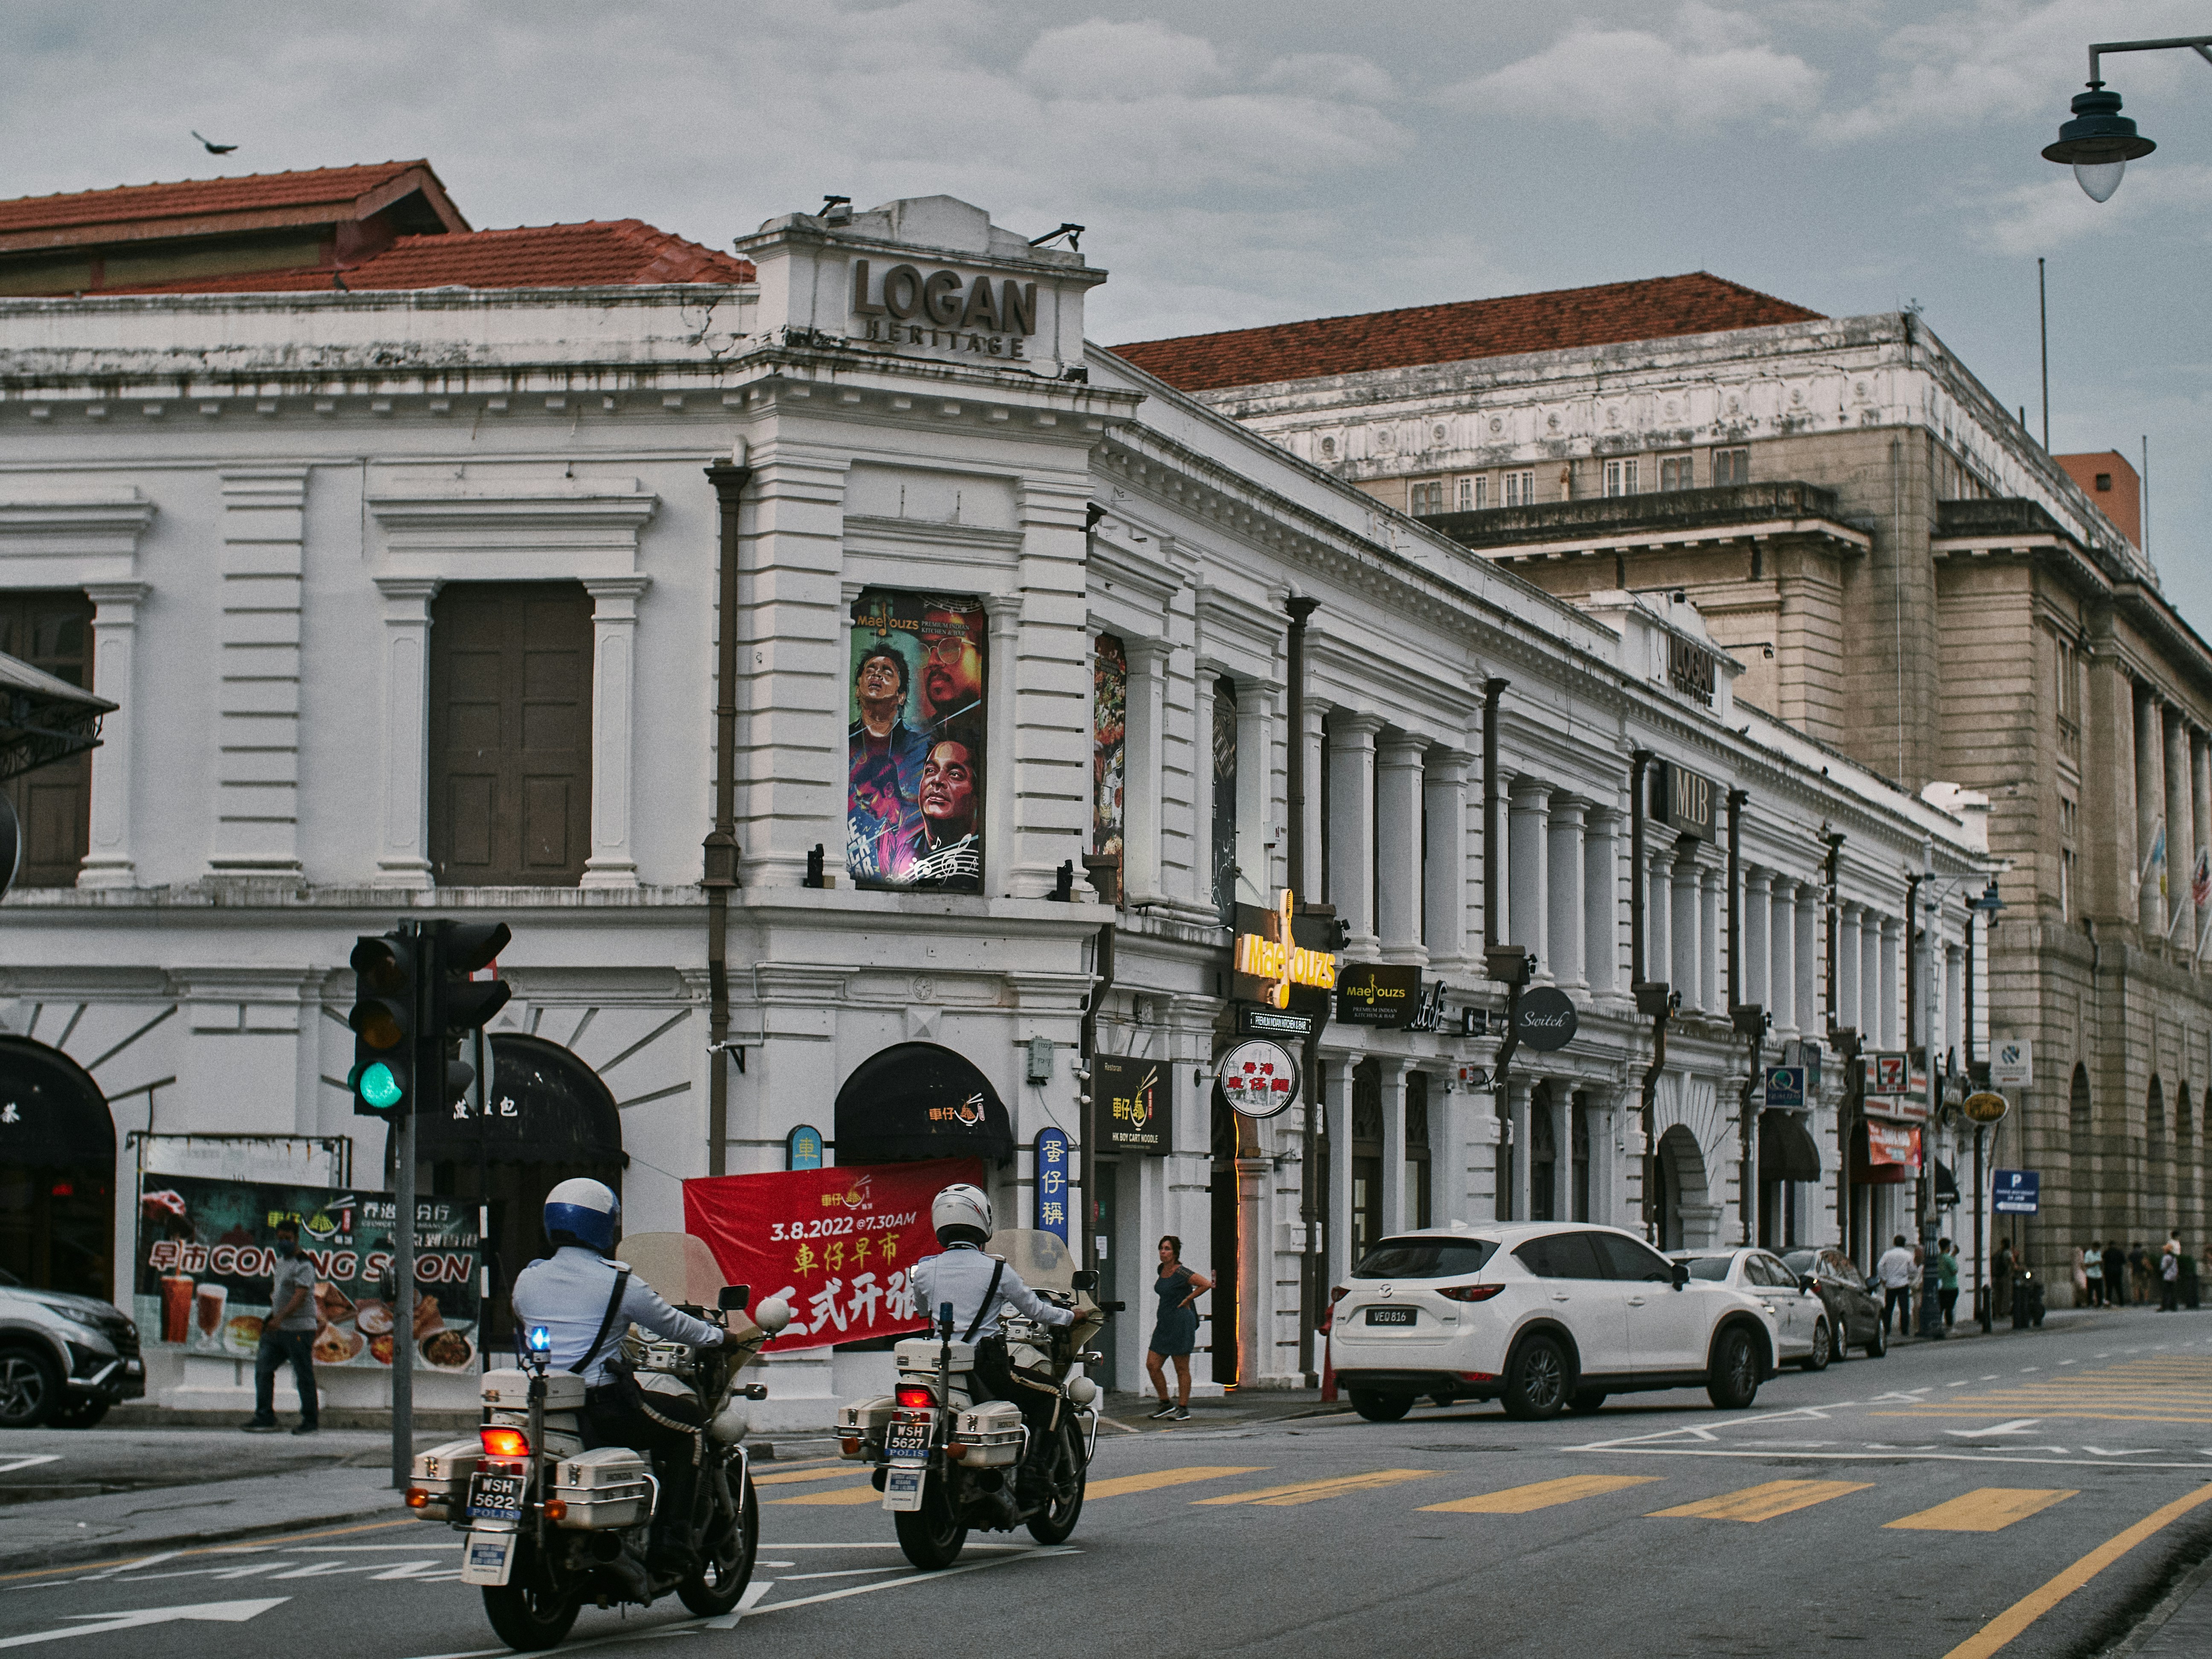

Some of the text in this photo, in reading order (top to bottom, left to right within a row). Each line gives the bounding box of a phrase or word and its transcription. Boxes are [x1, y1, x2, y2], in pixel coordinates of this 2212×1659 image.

[854, 259, 1037, 335] LOGAN
[865, 319, 1025, 358] HERITAGE
[921, 621, 949, 629] PREMIUM
[1670, 635, 1715, 694] LOGAN
[1676, 767, 1708, 825] MIB
[1411, 981, 1447, 1030] itch
[1520, 1010, 1570, 1027] Switch
[1105, 1062, 1122, 1072] Restoran
[1243, 1062, 1274, 1076] 香港
[1112, 1132, 1158, 1143] HK BOY CART NOODLE
[2011, 1173, 2022, 1188] P
[770, 1211, 917, 1241] 3.8.2022 @7.30AM
[794, 1232, 899, 1278] 車仔早市
[210, 1244, 359, 1281] COMNG
[362, 1251, 473, 1283] SON
[1391, 1311, 1406, 1322] 816
[897, 1426, 923, 1437] WSH
[892, 1437, 924, 1449] 5627
[482, 1478, 514, 1493] WSH
[474, 1493, 515, 1510] 5622
[472, 1508, 515, 1519] POLIS
